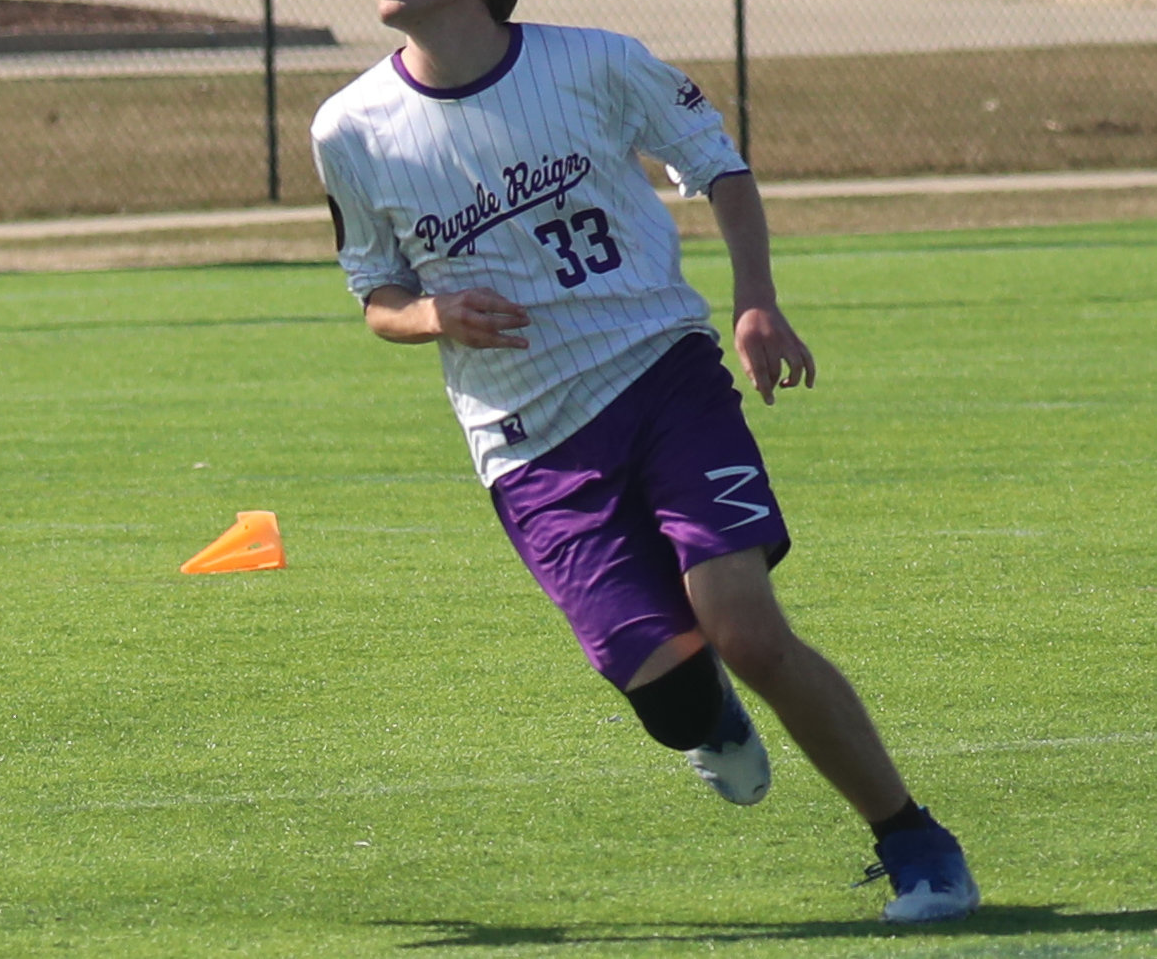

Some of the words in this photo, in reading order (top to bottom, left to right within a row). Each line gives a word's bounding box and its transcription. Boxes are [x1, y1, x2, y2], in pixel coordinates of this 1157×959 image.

[415, 183, 501, 255] Purple
[503, 152, 591, 210] Reign
[534, 207, 622, 289] 33
